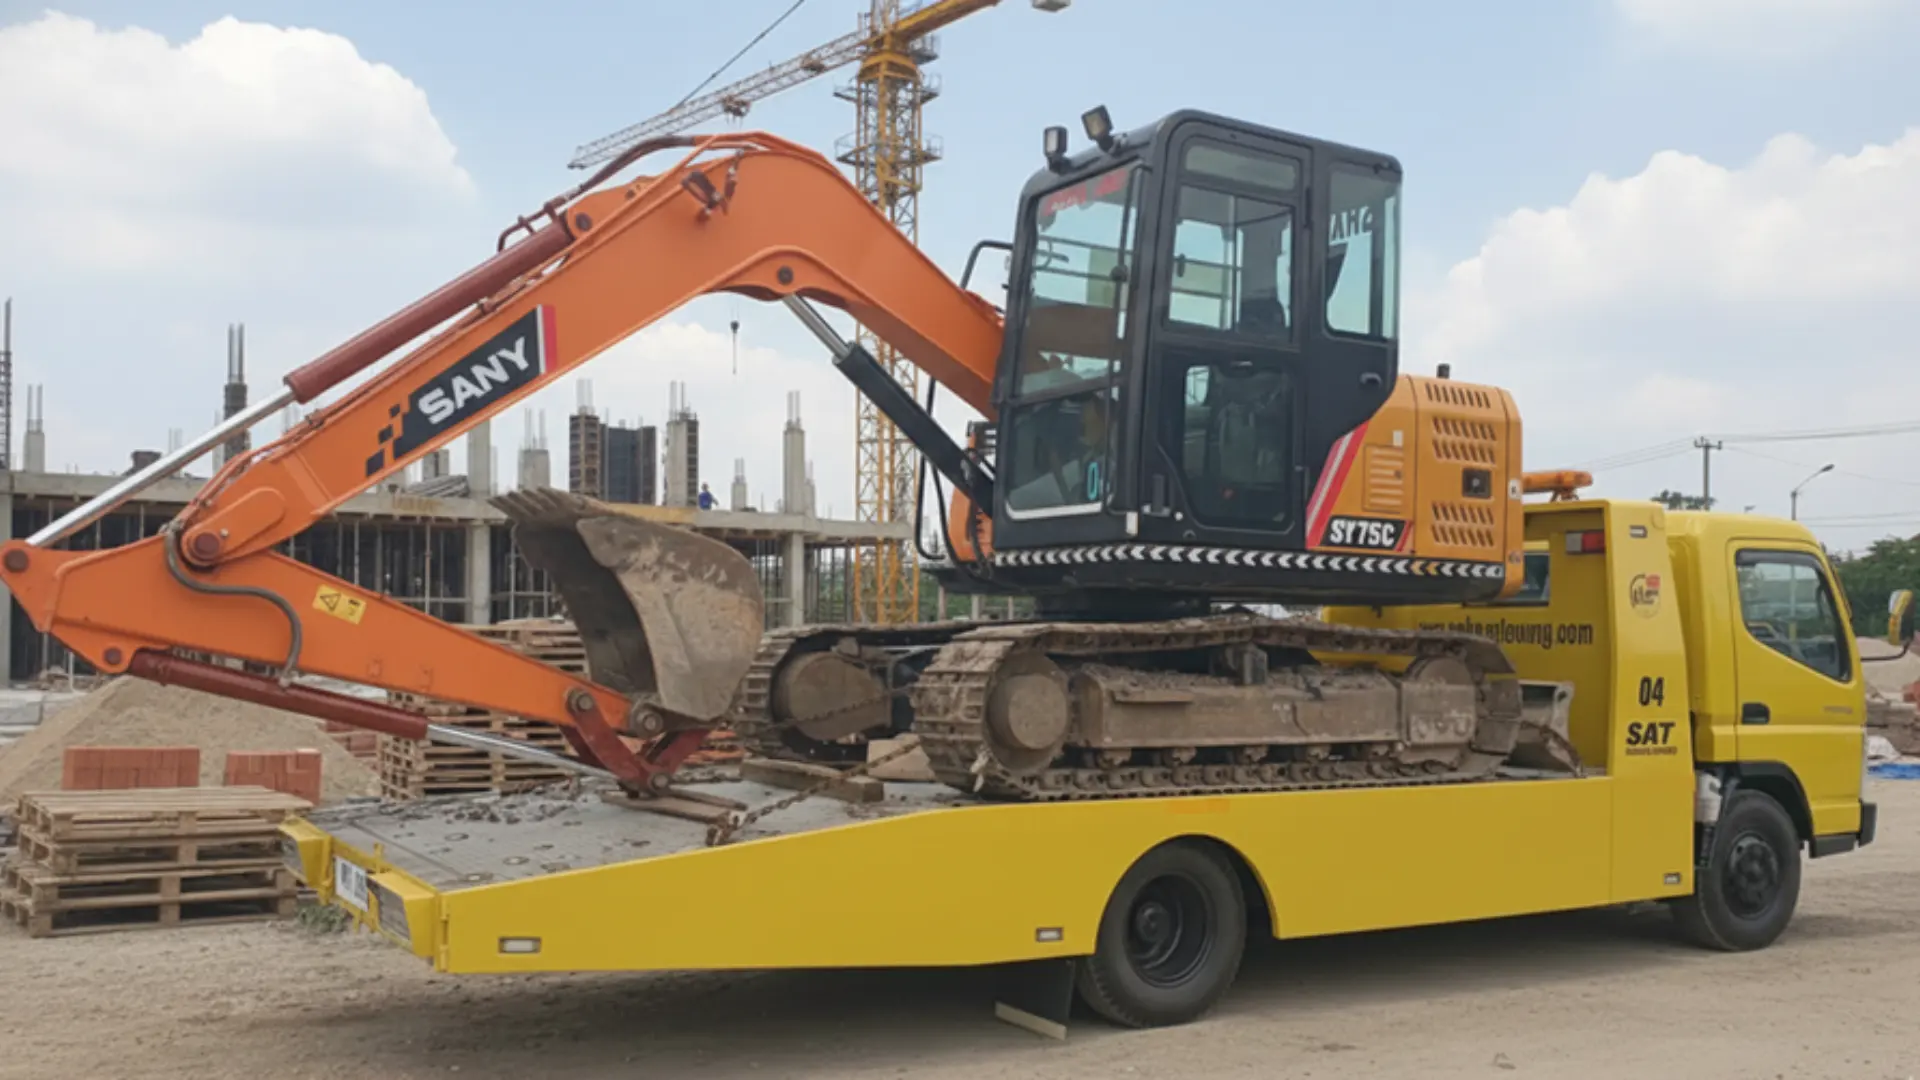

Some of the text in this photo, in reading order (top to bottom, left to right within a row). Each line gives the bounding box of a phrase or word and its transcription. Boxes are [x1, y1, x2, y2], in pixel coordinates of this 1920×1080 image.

[418, 336, 529, 424] SANY
[1330, 519, 1395, 547] SY75C
[1639, 676, 1664, 707] 04
[1627, 722, 1676, 745] SAT
